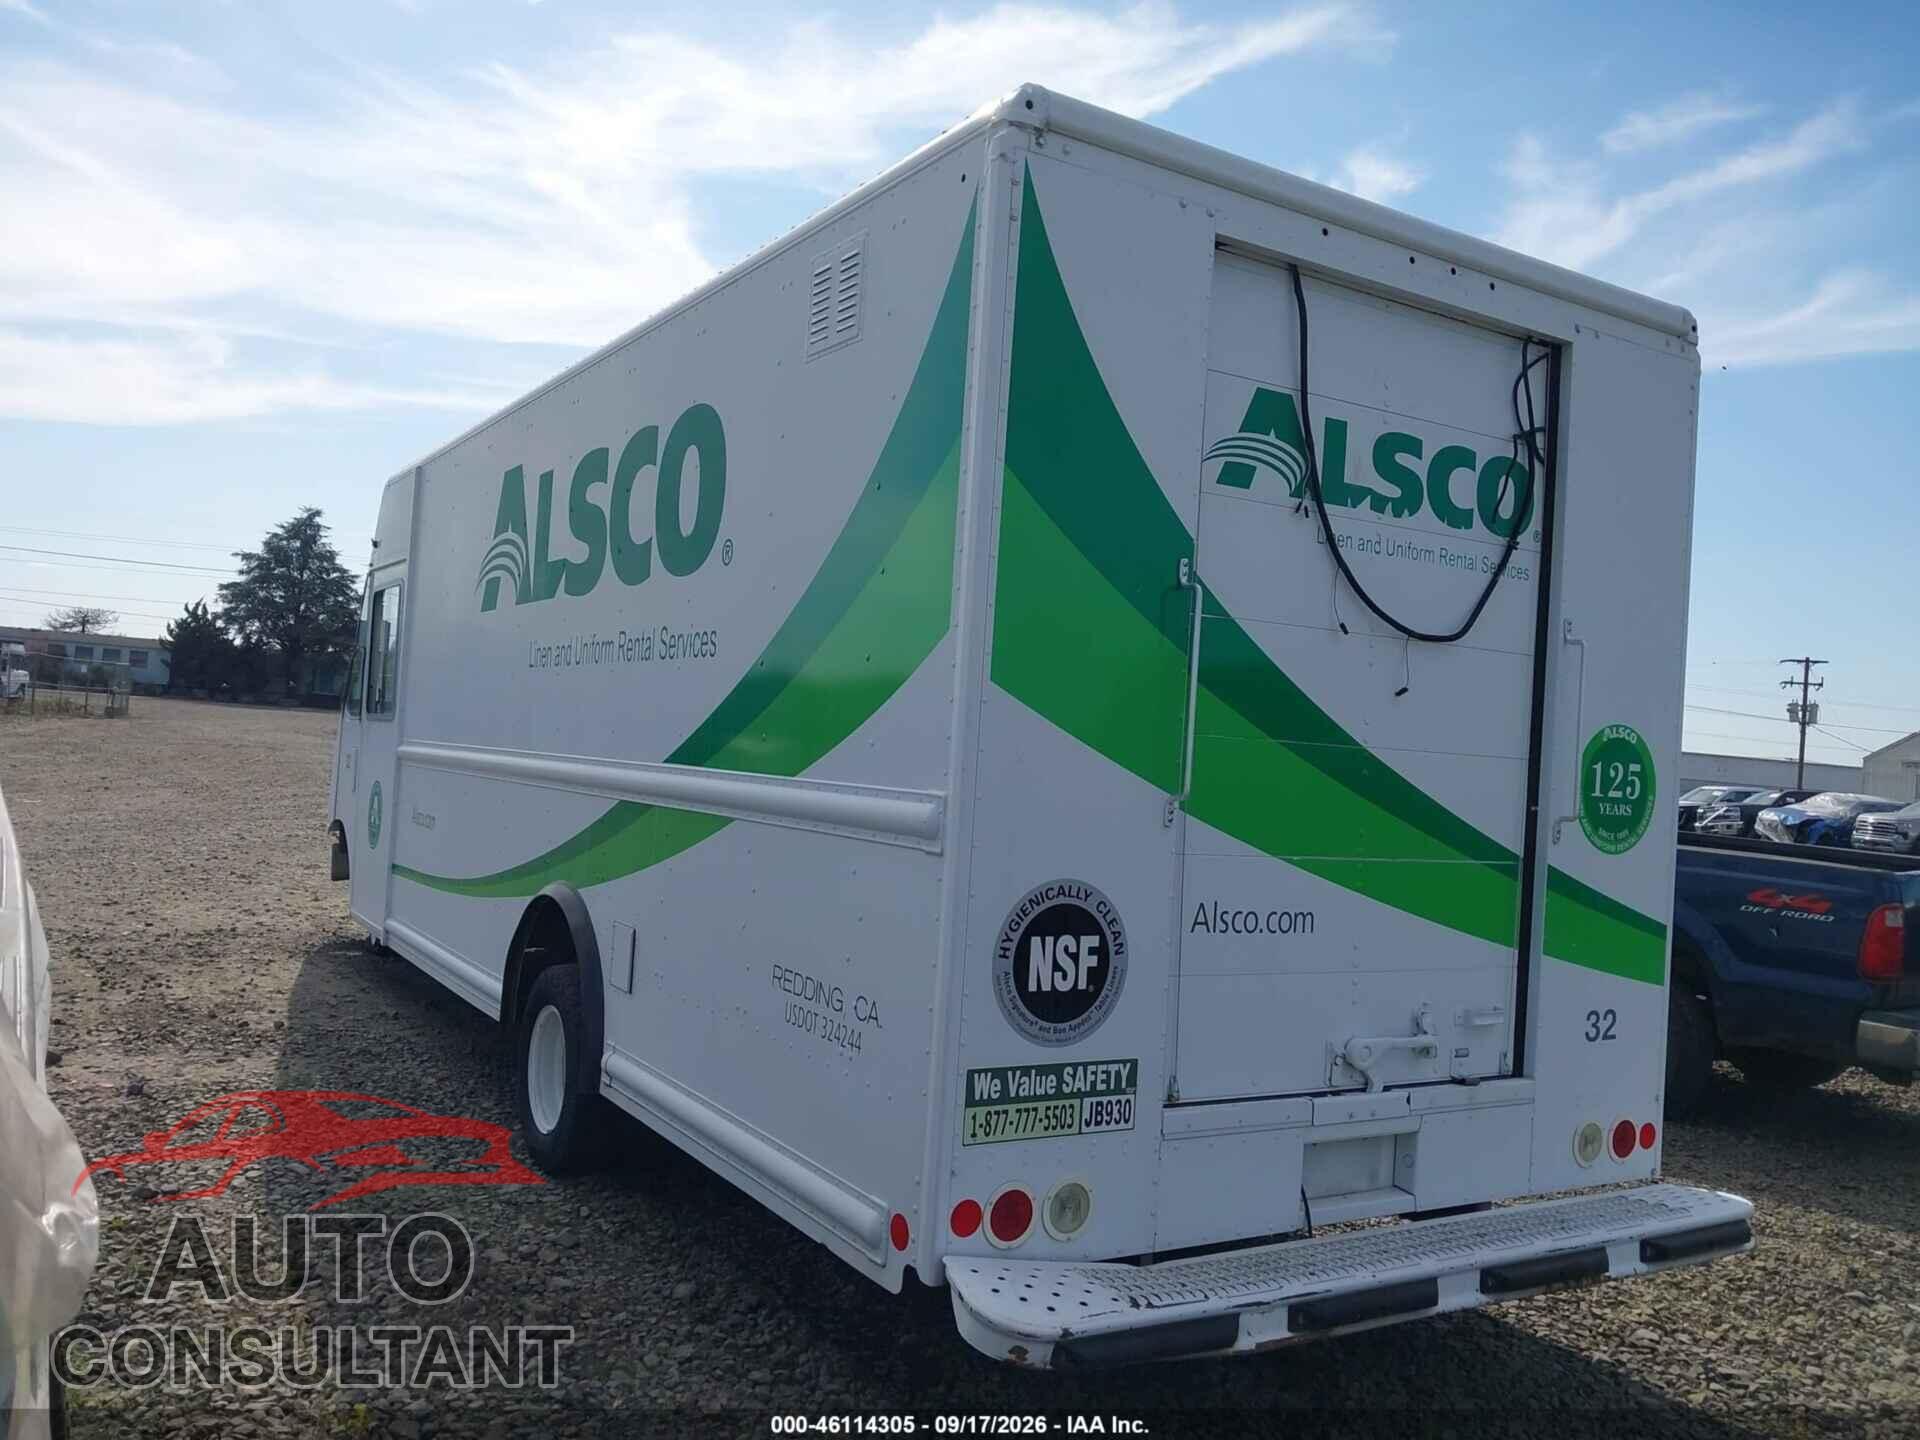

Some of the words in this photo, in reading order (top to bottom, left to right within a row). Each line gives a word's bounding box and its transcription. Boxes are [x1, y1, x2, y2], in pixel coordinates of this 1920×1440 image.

[1201, 386, 1535, 539] ALSCO
[474, 403, 727, 613] ALSCO
[1317, 525, 1353, 549] Len
[1358, 532, 1381, 554] and
[1386, 537, 1436, 563] Uniform
[1439, 547, 1478, 572] Rental
[1481, 555, 1530, 581] Seices
[528, 640, 552, 668] Linen
[554, 638, 573, 667] and
[575, 634, 615, 666] Uniform
[617, 627, 657, 663] Rental
[659, 625, 718, 660] Services
[1604, 726, 1638, 745] ALSCO
[1591, 760, 1642, 800] 125
[1599, 802, 1633, 817] YEARS
[998, 884, 1094, 960] HYGIENICALLY
[1096, 900, 1125, 957] CLEAN
[1190, 900, 1315, 934] Alsco.com
[1739, 904, 1777, 915] OFF
[1780, 909, 1836, 923] ROAD
[1028, 934, 1100, 992] NSF
[772, 964, 847, 1020] REDDING,
[784, 1000, 819, 1035] USDOT
[821, 1016, 862, 1056] 324244
[1585, 1008, 1617, 1042] 32
[973, 1072, 1001, 1100] We
[1008, 1069, 1057, 1098] Value
[1062, 1063, 1131, 1094] SAFETY
[970, 1103, 1075, 1139] 1-877-777-5503
[1084, 1098, 1132, 1128] JB930
